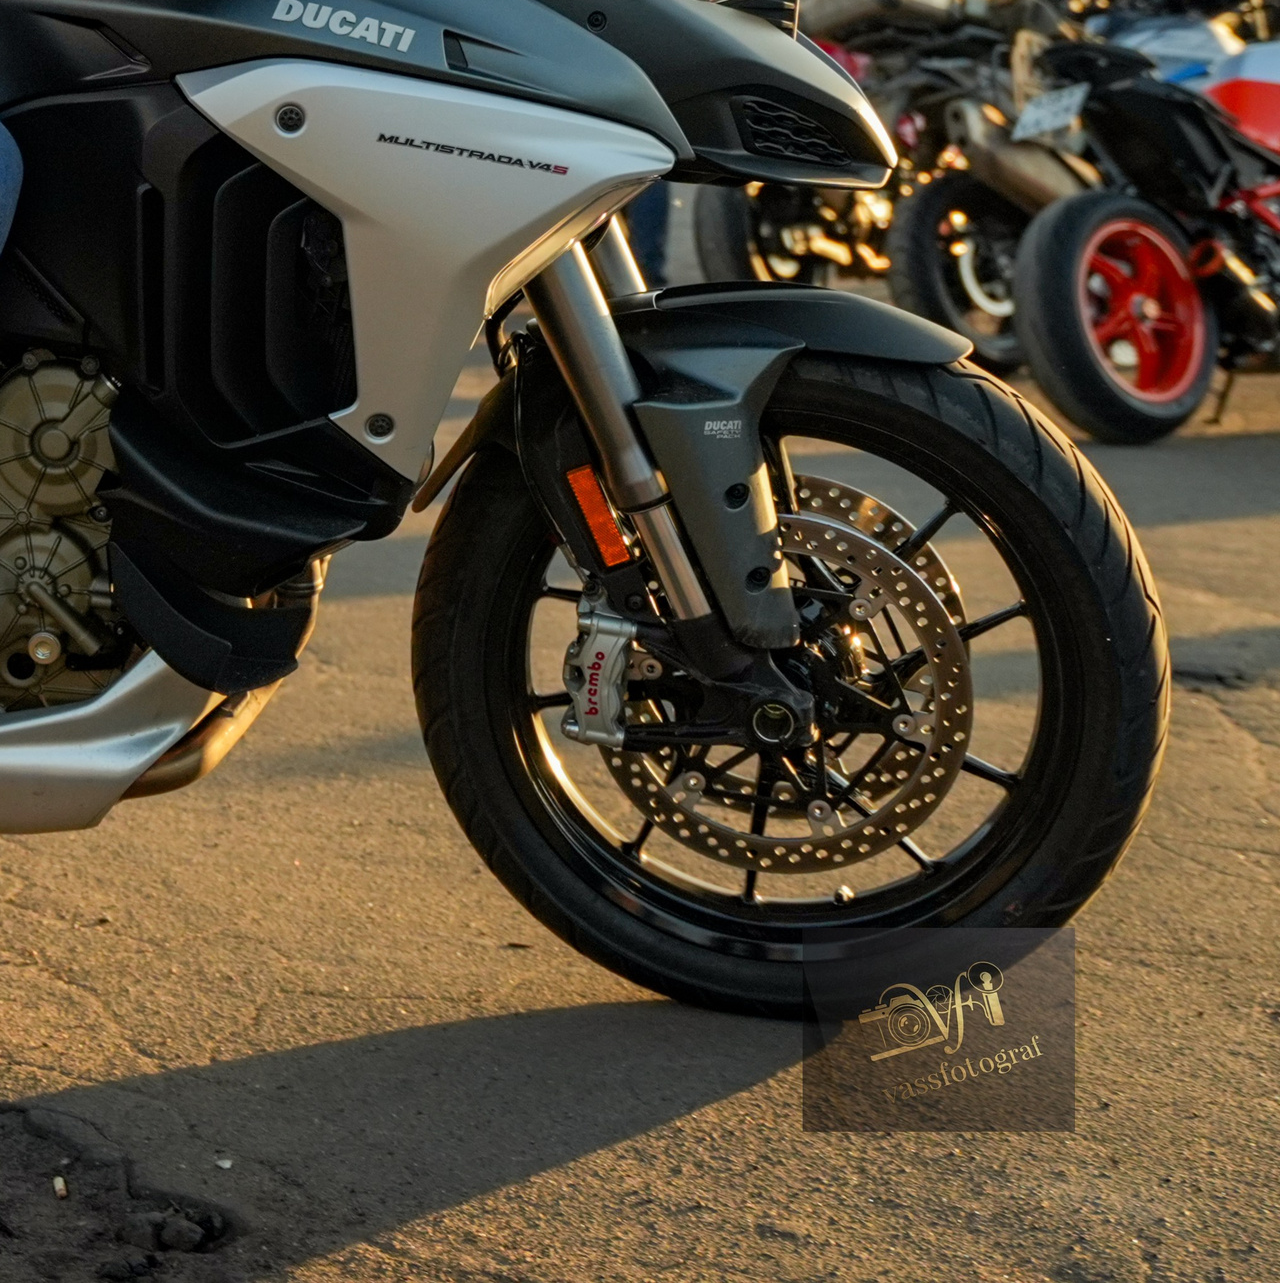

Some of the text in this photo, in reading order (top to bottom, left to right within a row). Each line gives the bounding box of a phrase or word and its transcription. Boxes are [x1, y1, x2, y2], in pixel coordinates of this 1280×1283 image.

[376, 133, 525, 169] MULTISTRADA
[704, 420, 742, 431] DUCATI
[585, 651, 605, 716] brembo
